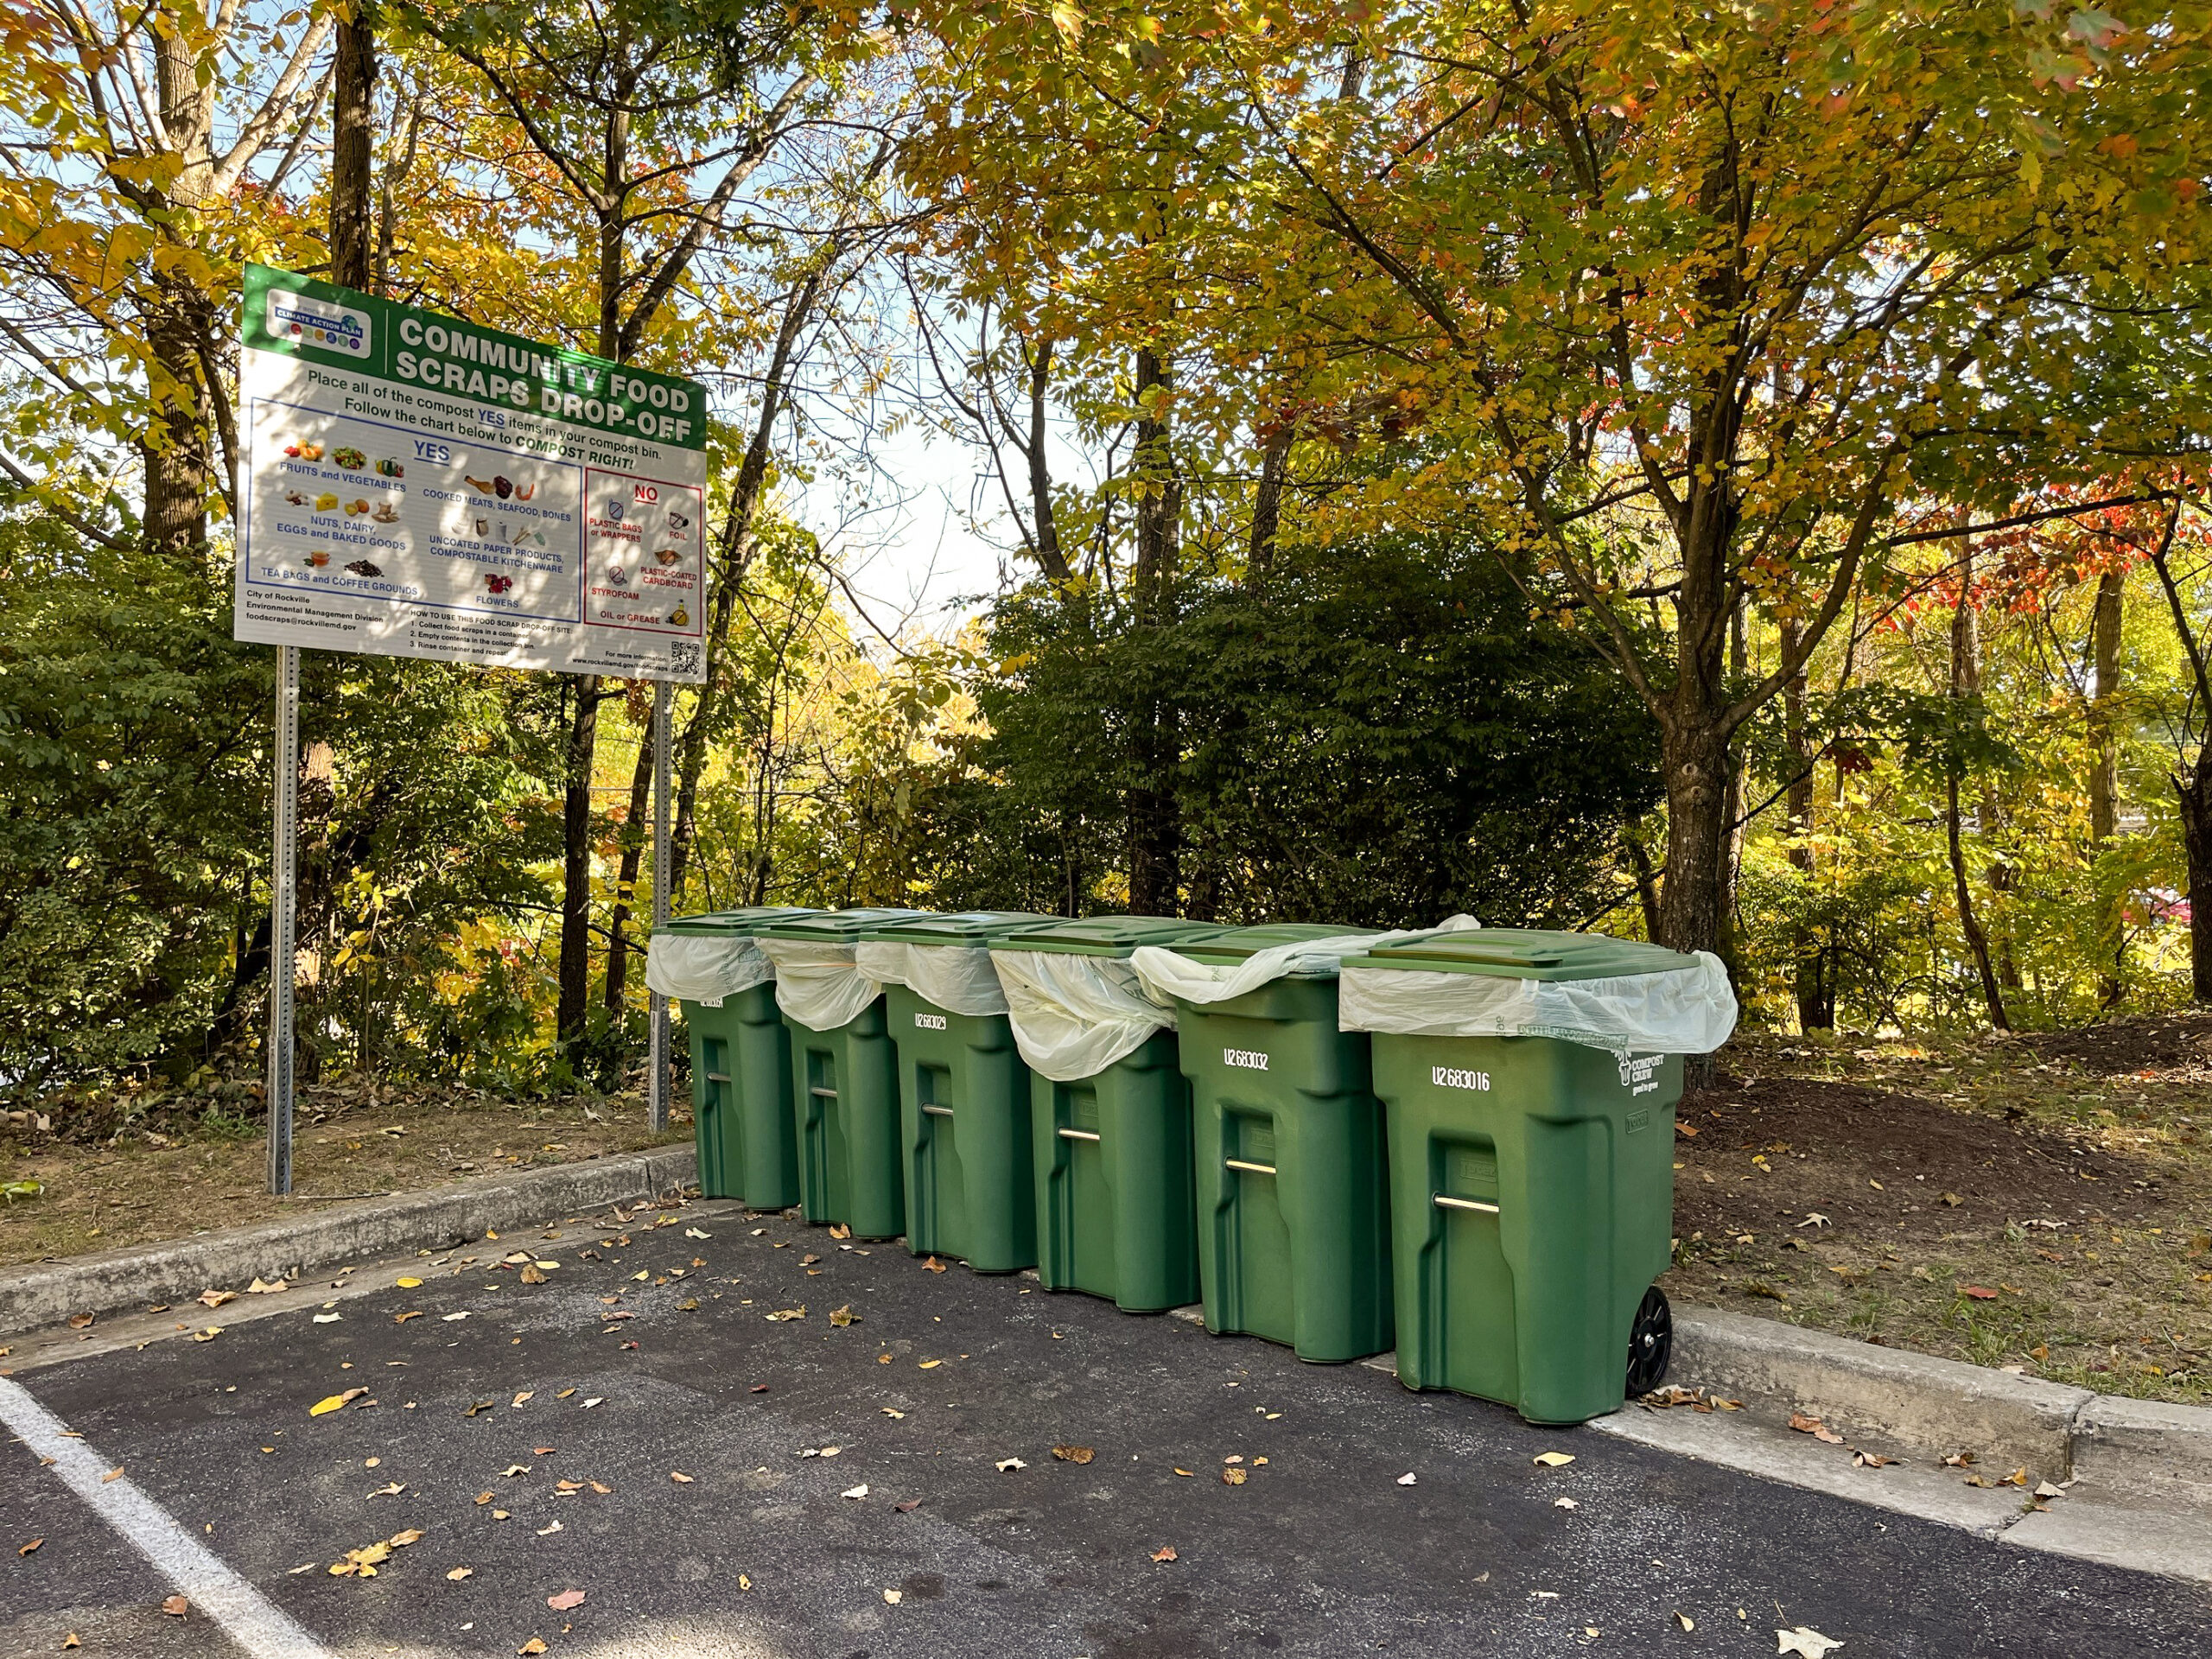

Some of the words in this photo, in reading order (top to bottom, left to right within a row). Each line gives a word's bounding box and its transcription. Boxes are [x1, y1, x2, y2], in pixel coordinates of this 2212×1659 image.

[277, 310, 309, 322] CLIMATE
[312, 319, 340, 330] ACTION
[341, 327, 361, 335] PLAN
[400, 319, 600, 391] COMMUNITY
[611, 373, 689, 412] FOOD
[396, 352, 530, 406] SCRAPS
[541, 387, 691, 442] DROP-OFF
[308, 370, 347, 389] Place
[353, 381, 368, 394] all
[373, 385, 387, 398] of
[391, 389, 413, 404] the
[416, 398, 474, 421] compost
[478, 409, 505, 426] YES
[508, 416, 541, 434] items
[545, 425, 556, 437] in
[560, 431, 586, 444] your
[589, 437, 639, 455] compost
[641, 447, 662, 460] bin.
[346, 397, 391, 418] Follow
[395, 408, 416, 423] the
[421, 416, 454, 432] chart
[459, 422, 496, 444] below
[499, 431, 512, 444] to
[516, 435, 585, 460] COMPOST
[588, 451, 634, 470] RIGHT!
[415, 441, 449, 461] YES
[280, 461, 318, 475] FRUITS
[321, 471, 339, 480] and
[342, 474, 406, 493] VEGETABLES
[635, 484, 658, 501] NO
[423, 489, 461, 503] COOKED
[465, 496, 496, 510] MEATS,
[498, 503, 541, 518] SEAFOOD,
[543, 510, 571, 522] BONES
[311, 517, 340, 530] NUTS,
[344, 522, 377, 535] DAIRY,
[589, 518, 620, 529] PLASTIC
[622, 524, 642, 533] BAGS
[277, 524, 308, 536] EGGS
[311, 529, 328, 539] and
[333, 532, 366, 544] BAKED
[370, 537, 406, 550] GOODS
[600, 531, 641, 543] WRAPPERS
[669, 531, 687, 541] FOIL
[430, 536, 479, 550] UNCOATED
[484, 543, 512, 555] PAPER
[516, 549, 563, 563] PRODUCTS,
[430, 548, 499, 564] COMPOSTABLE
[501, 558, 563, 574] KITCHENWARE
[261, 568, 280, 577] TEA
[283, 570, 309, 582] BAGS
[313, 574, 330, 584] and
[333, 577, 369, 589] COFFEE
[372, 582, 417, 595] GROUNDS
[641, 567, 696, 581] PLASTIC-COATED
[643, 576, 693, 589] CARDBOARD
[247, 590, 262, 599] City
[276, 593, 309, 603] Rockville
[476, 596, 518, 608] FLOWERS
[592, 588, 639, 600] STYROFOAM
[247, 601, 302, 613] Environmental
[305, 608, 353, 620] Management
[355, 613, 384, 622] Division
[600, 610, 614, 619] OIL
[627, 613, 660, 624] GREASE
[246, 613, 356, 631] foodscraps@rockvillemd.gov
[475, 617, 494, 626] FOOD
[522, 623, 555, 632] DROP-OFF
[418, 632, 439, 641] Empty
[442, 634, 470, 643] contents
[493, 639, 523, 648] collection
[461, 627, 484, 636] scraps
[418, 641, 437, 650] Rinse
[439, 645, 470, 653] container
[1224, 1048, 1268, 1071] U2683032
[1632, 1054, 1664, 1071] COMPOST
[1433, 1066, 1490, 1091] U2683016
[1631, 1068, 1652, 1082] CREW
